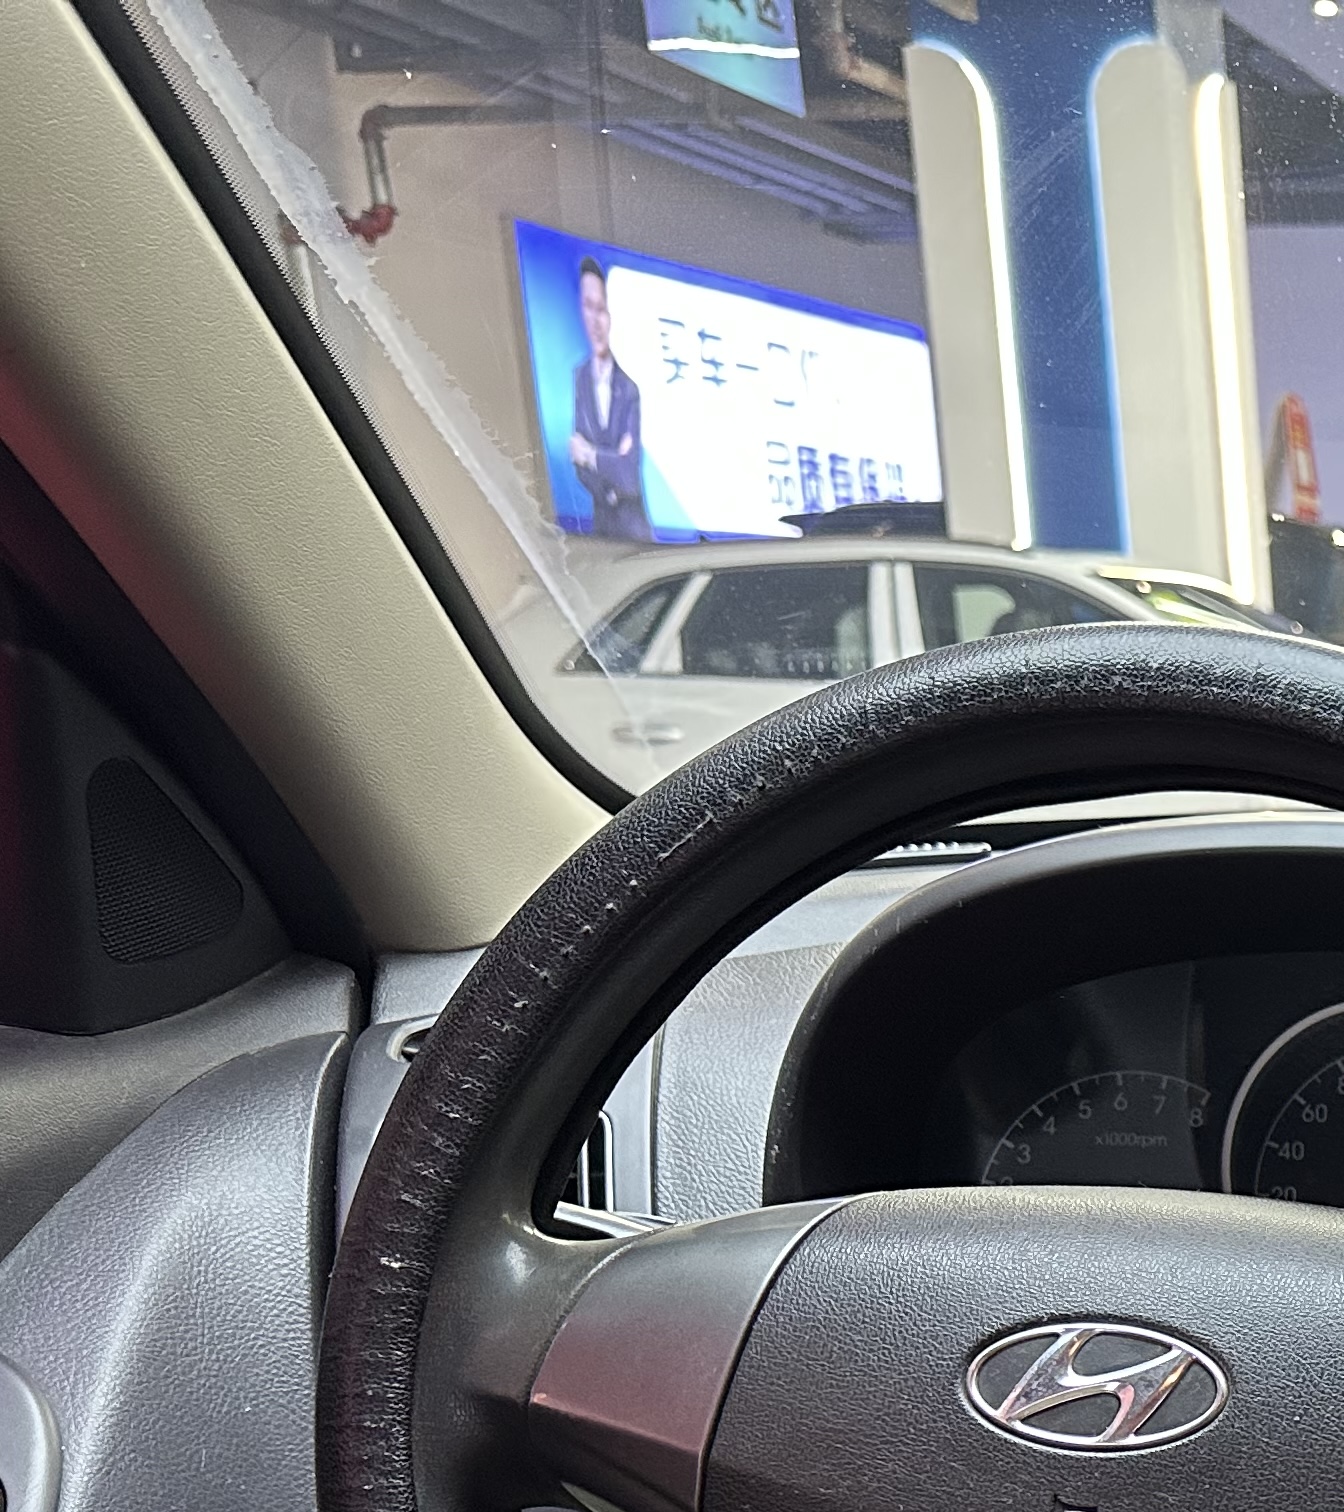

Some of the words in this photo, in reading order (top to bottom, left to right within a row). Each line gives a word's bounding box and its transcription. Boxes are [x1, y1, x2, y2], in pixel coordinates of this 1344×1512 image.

[1078, 1100, 1092, 1119] 5
[1113, 1092, 1128, 1111] 6
[1153, 1095, 1167, 1114] 7
[1189, 1107, 1204, 1127] 8
[1301, 1103, 1328, 1123] 60
[1043, 1116, 1056, 1135] 4
[1017, 1143, 1031, 1164] 3
[1277, 1140, 1305, 1161] 40
